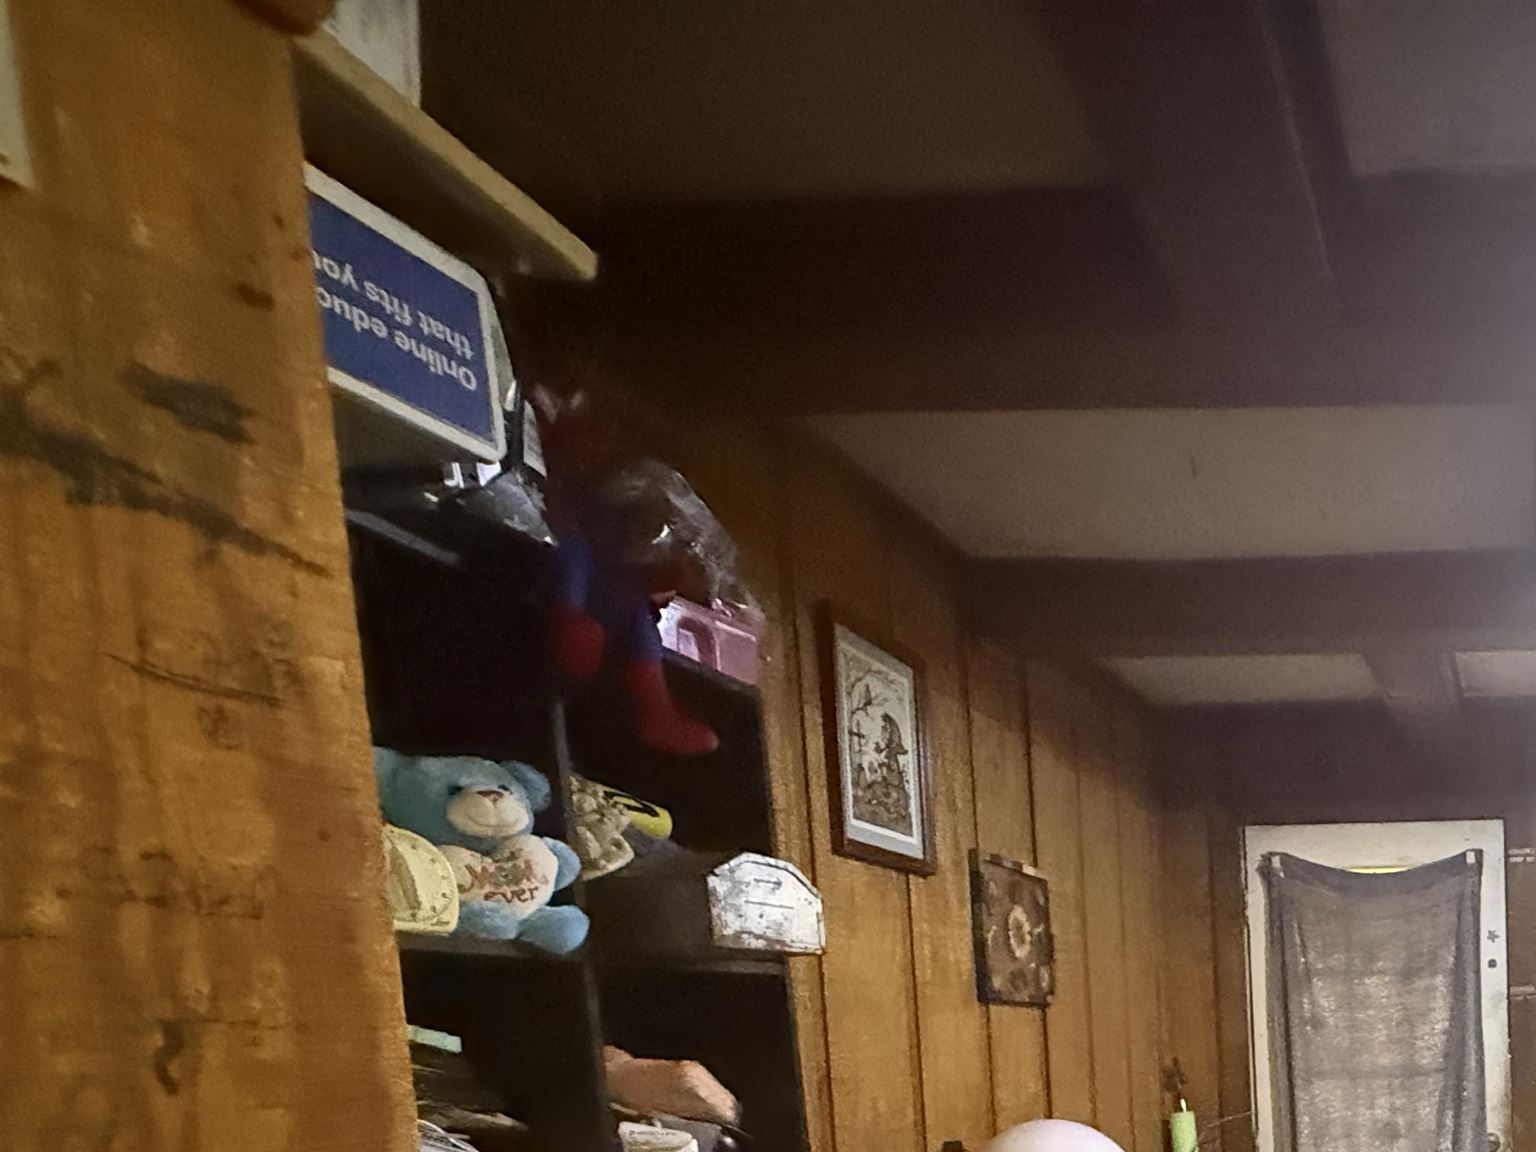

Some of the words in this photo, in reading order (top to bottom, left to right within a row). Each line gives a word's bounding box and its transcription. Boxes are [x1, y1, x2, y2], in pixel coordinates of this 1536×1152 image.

[363, 279, 412, 326] fits
[394, 328, 477, 390] Online
[418, 311, 474, 360] that
[484, 885, 540, 904] ever
